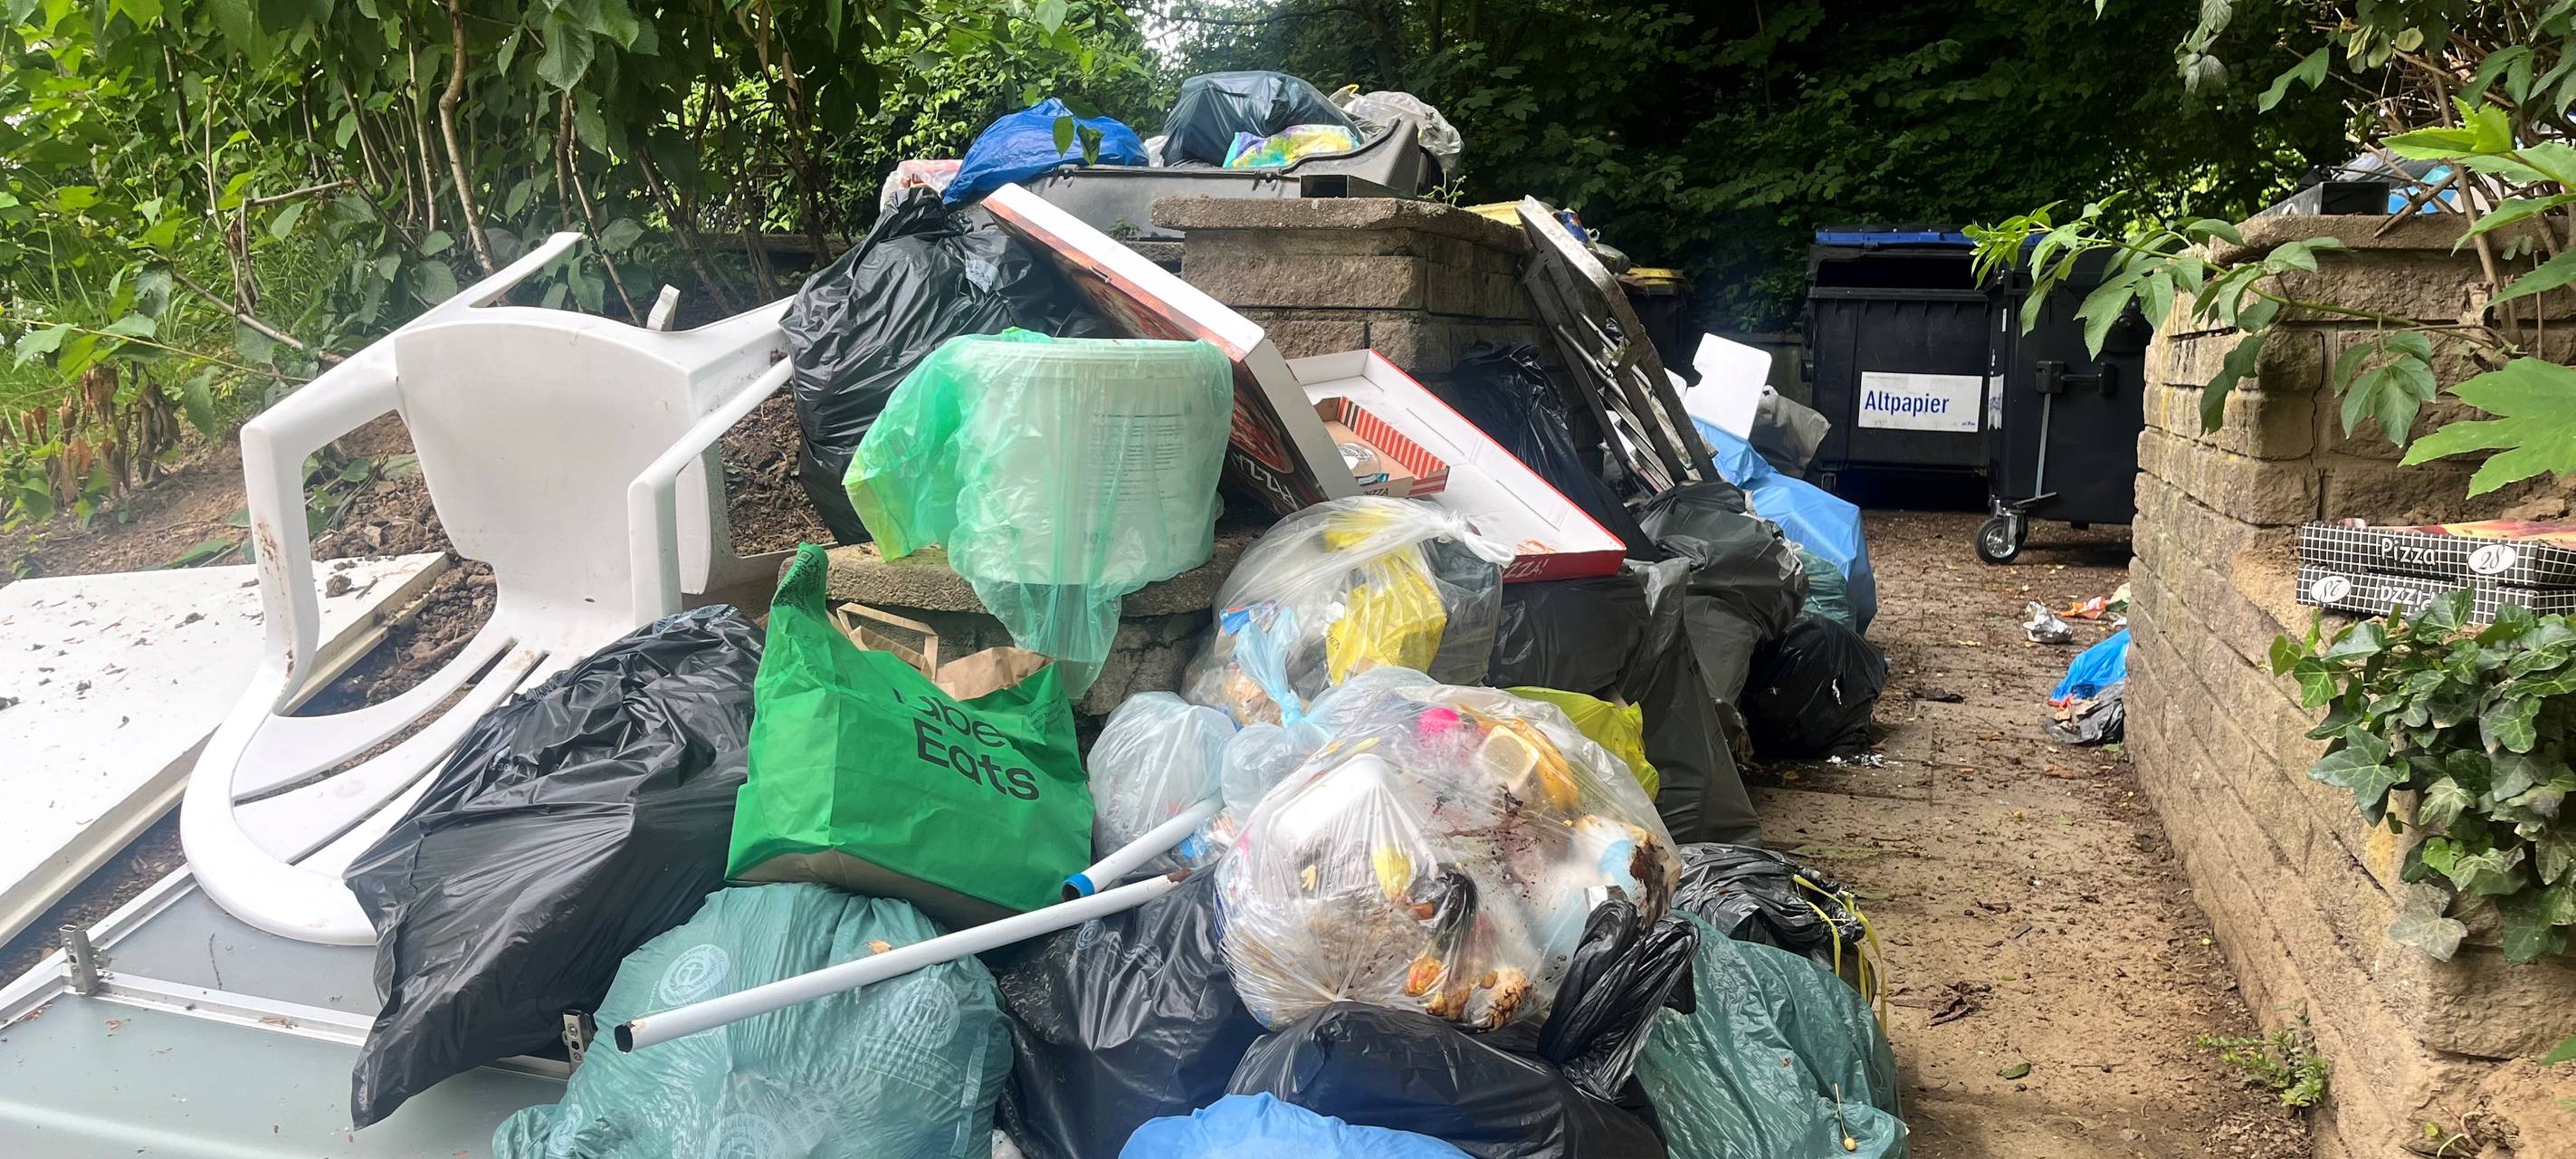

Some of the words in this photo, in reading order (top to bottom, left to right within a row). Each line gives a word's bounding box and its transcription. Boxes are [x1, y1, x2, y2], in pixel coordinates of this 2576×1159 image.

[1865, 390, 1950, 417] Altpapier
[2380, 538, 2437, 567] Pizza
[912, 716, 1040, 800] Eats
